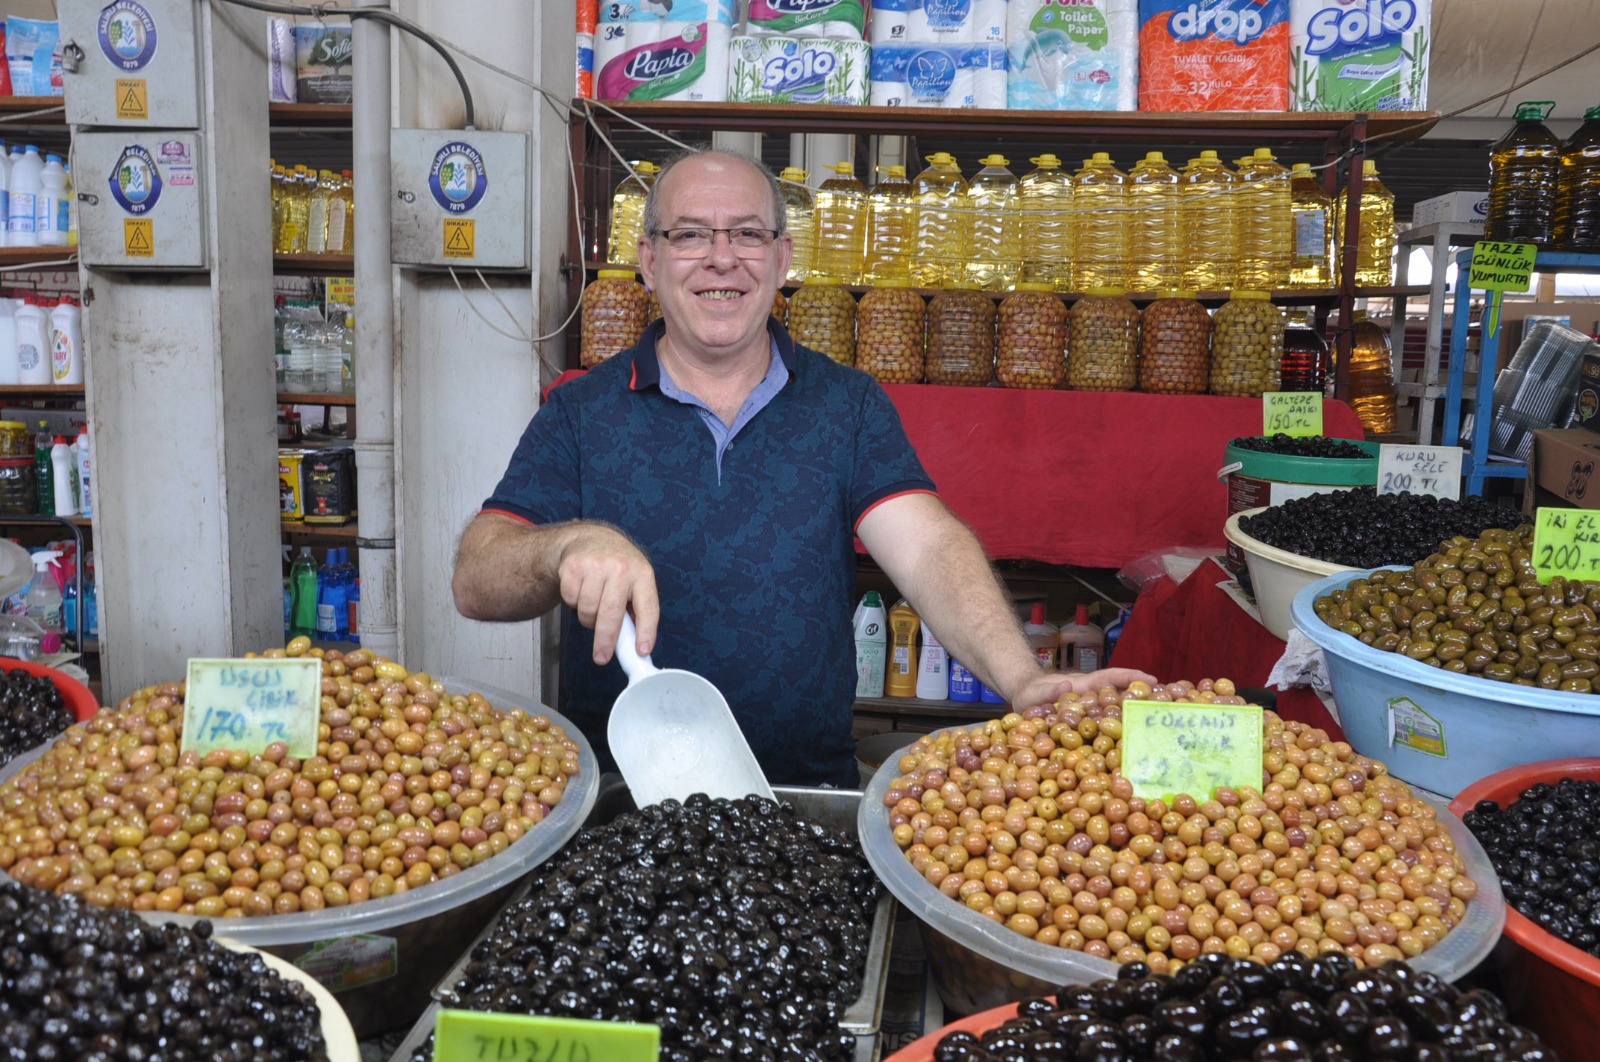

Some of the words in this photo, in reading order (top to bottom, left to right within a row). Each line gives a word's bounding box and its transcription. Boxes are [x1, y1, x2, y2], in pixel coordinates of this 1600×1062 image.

[1060, 11, 1094, 22] Toilet
[1171, 3, 1263, 42] drop
[1068, 24, 1105, 36] Paper
[122, 60, 139, 68] 1879
[629, 47, 691, 78] Papia
[1173, 55, 1212, 63] TUVALET
[1188, 82, 1209, 95] 32
[131, 203, 146, 212] 1879
[449, 203, 466, 211] 1879
[1478, 242, 1525, 254] TAZE
[1473, 254, 1532, 271] GÜNLÜK
[1471, 269, 1528, 285] YUMURTA
[1395, 451, 1436, 462] KURU
[1576, 515, 1596, 529] EL
